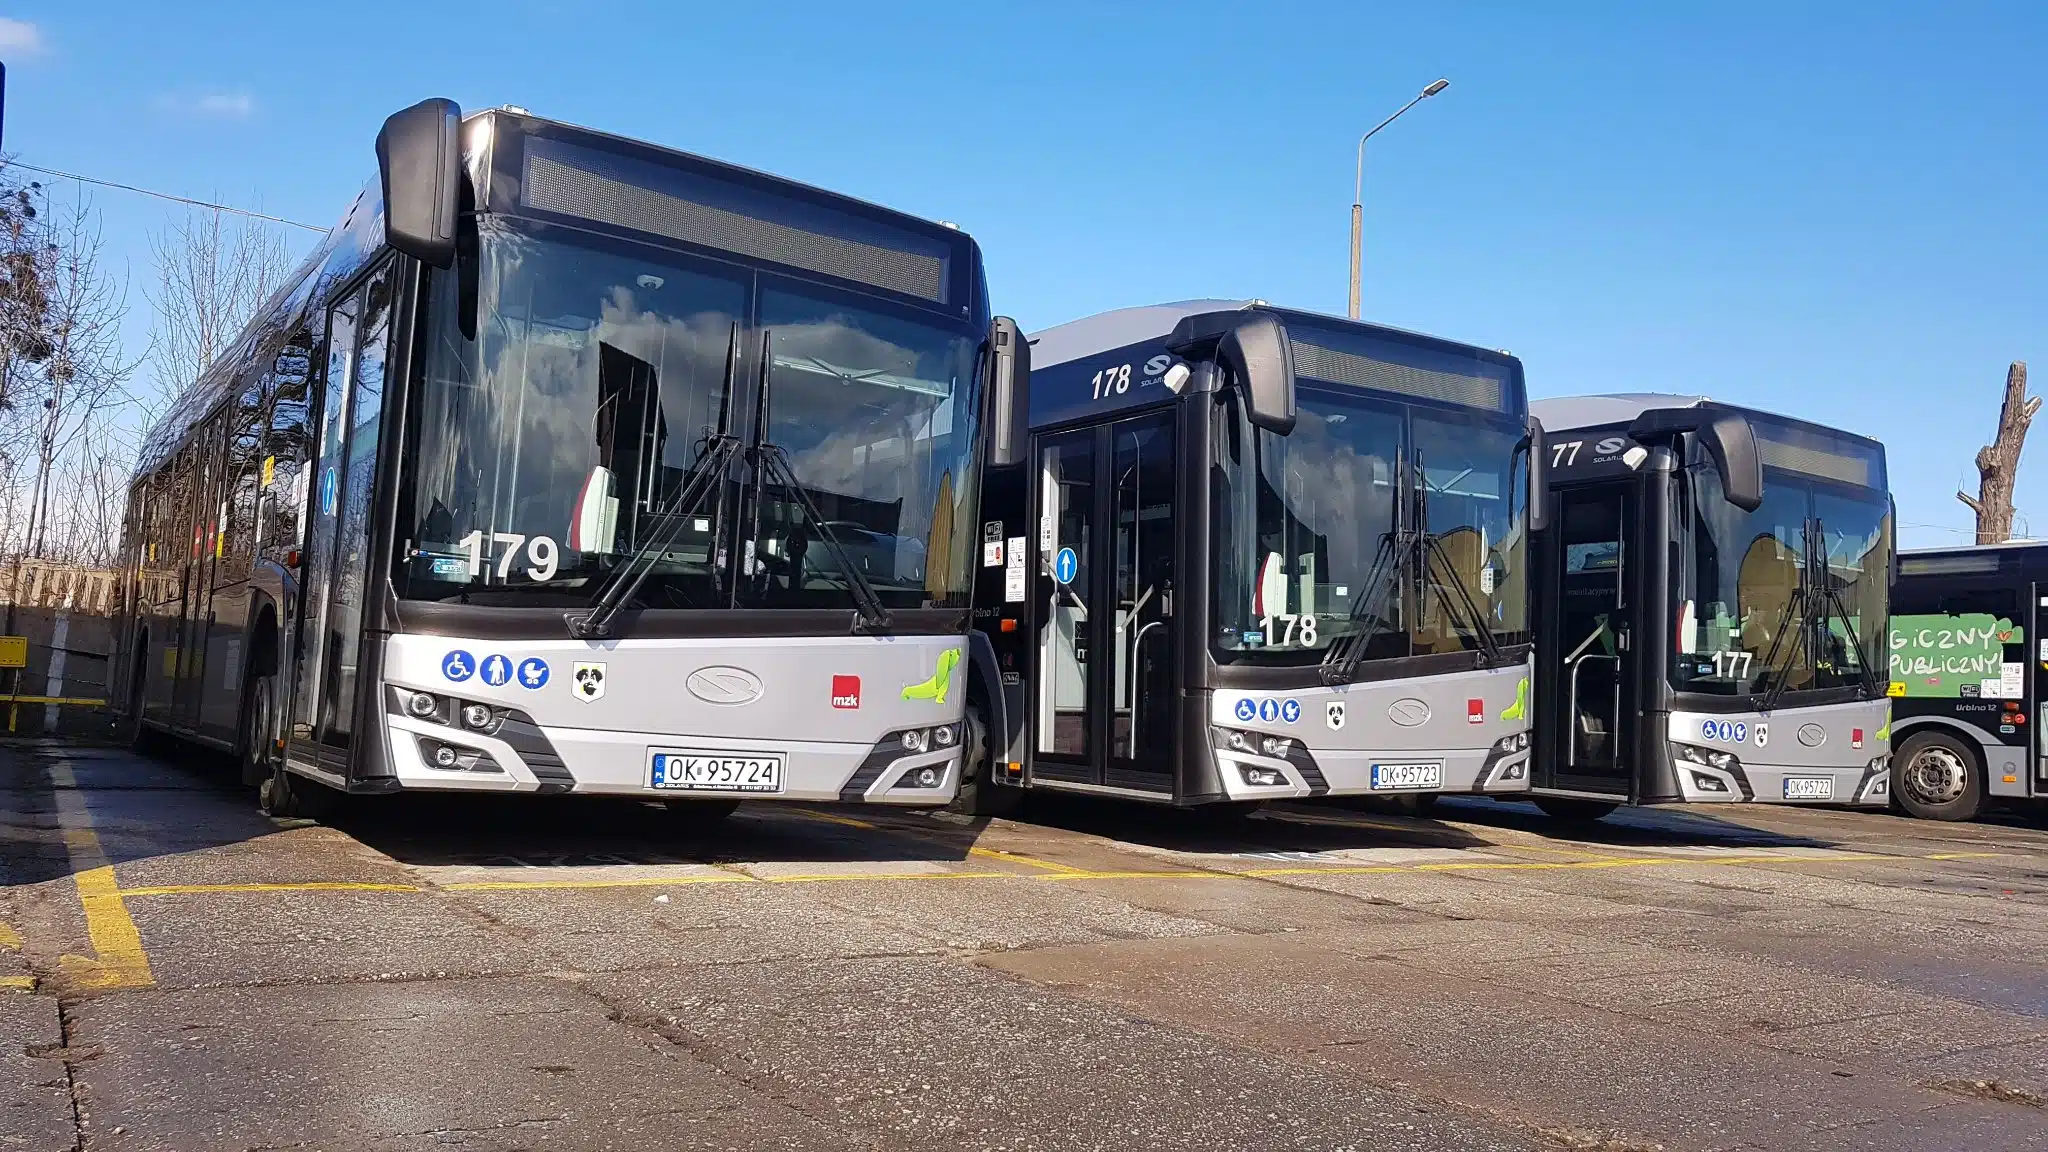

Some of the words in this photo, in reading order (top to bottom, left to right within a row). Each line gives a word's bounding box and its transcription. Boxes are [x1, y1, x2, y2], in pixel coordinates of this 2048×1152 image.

[1092, 364, 1131, 399] 178
[1552, 441, 1583, 468] 77
[459, 530, 559, 581] 179
[973, 608, 991, 619] rbino
[1260, 614, 1318, 647] 178
[1712, 651, 1753, 678] 177
[833, 693, 858, 706] mzk
[1956, 704, 1986, 712] Urbino
[1987, 704, 1997, 712] 12
[670, 758, 698, 781] OK
[707, 759, 773, 783] 95724
[1381, 766, 1396, 783] OK
[1401, 766, 1437, 782] 95723
[1790, 780, 1801, 794] OK
[1804, 780, 1829, 794] 95722
